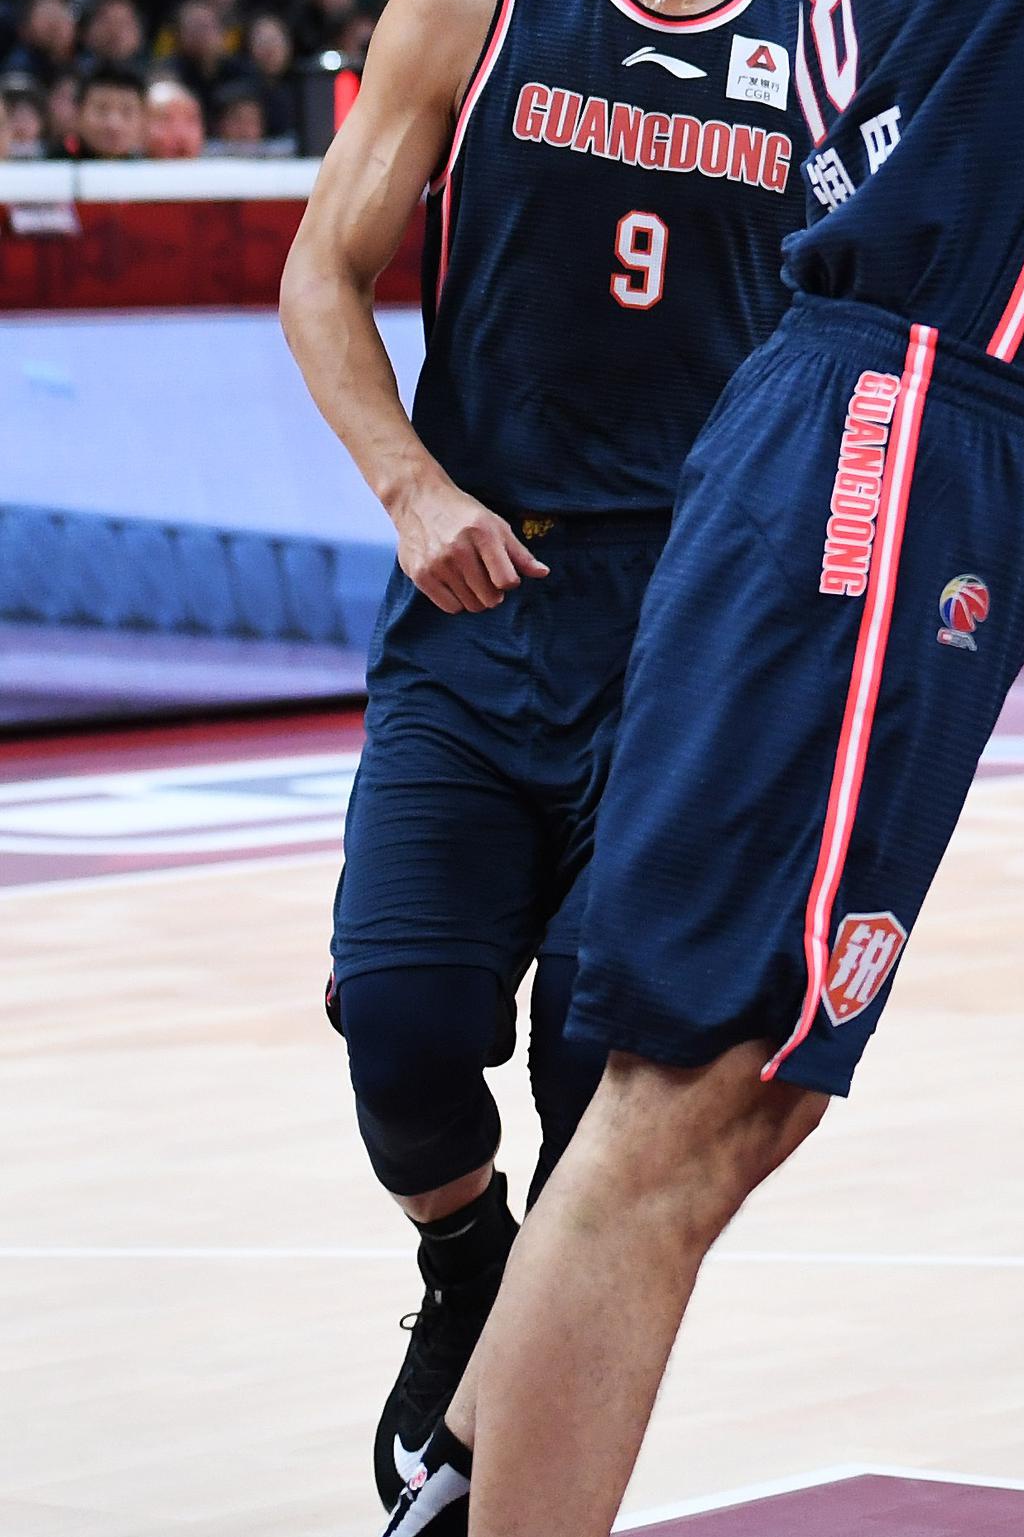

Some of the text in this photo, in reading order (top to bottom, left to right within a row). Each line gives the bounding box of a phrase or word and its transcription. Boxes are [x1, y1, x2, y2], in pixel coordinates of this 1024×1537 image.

[512, 82, 792, 194] GUANGDONG
[744, 88, 771, 101] CGB
[610, 210, 668, 310] 9
[818, 370, 901, 597] GUANGDONG
